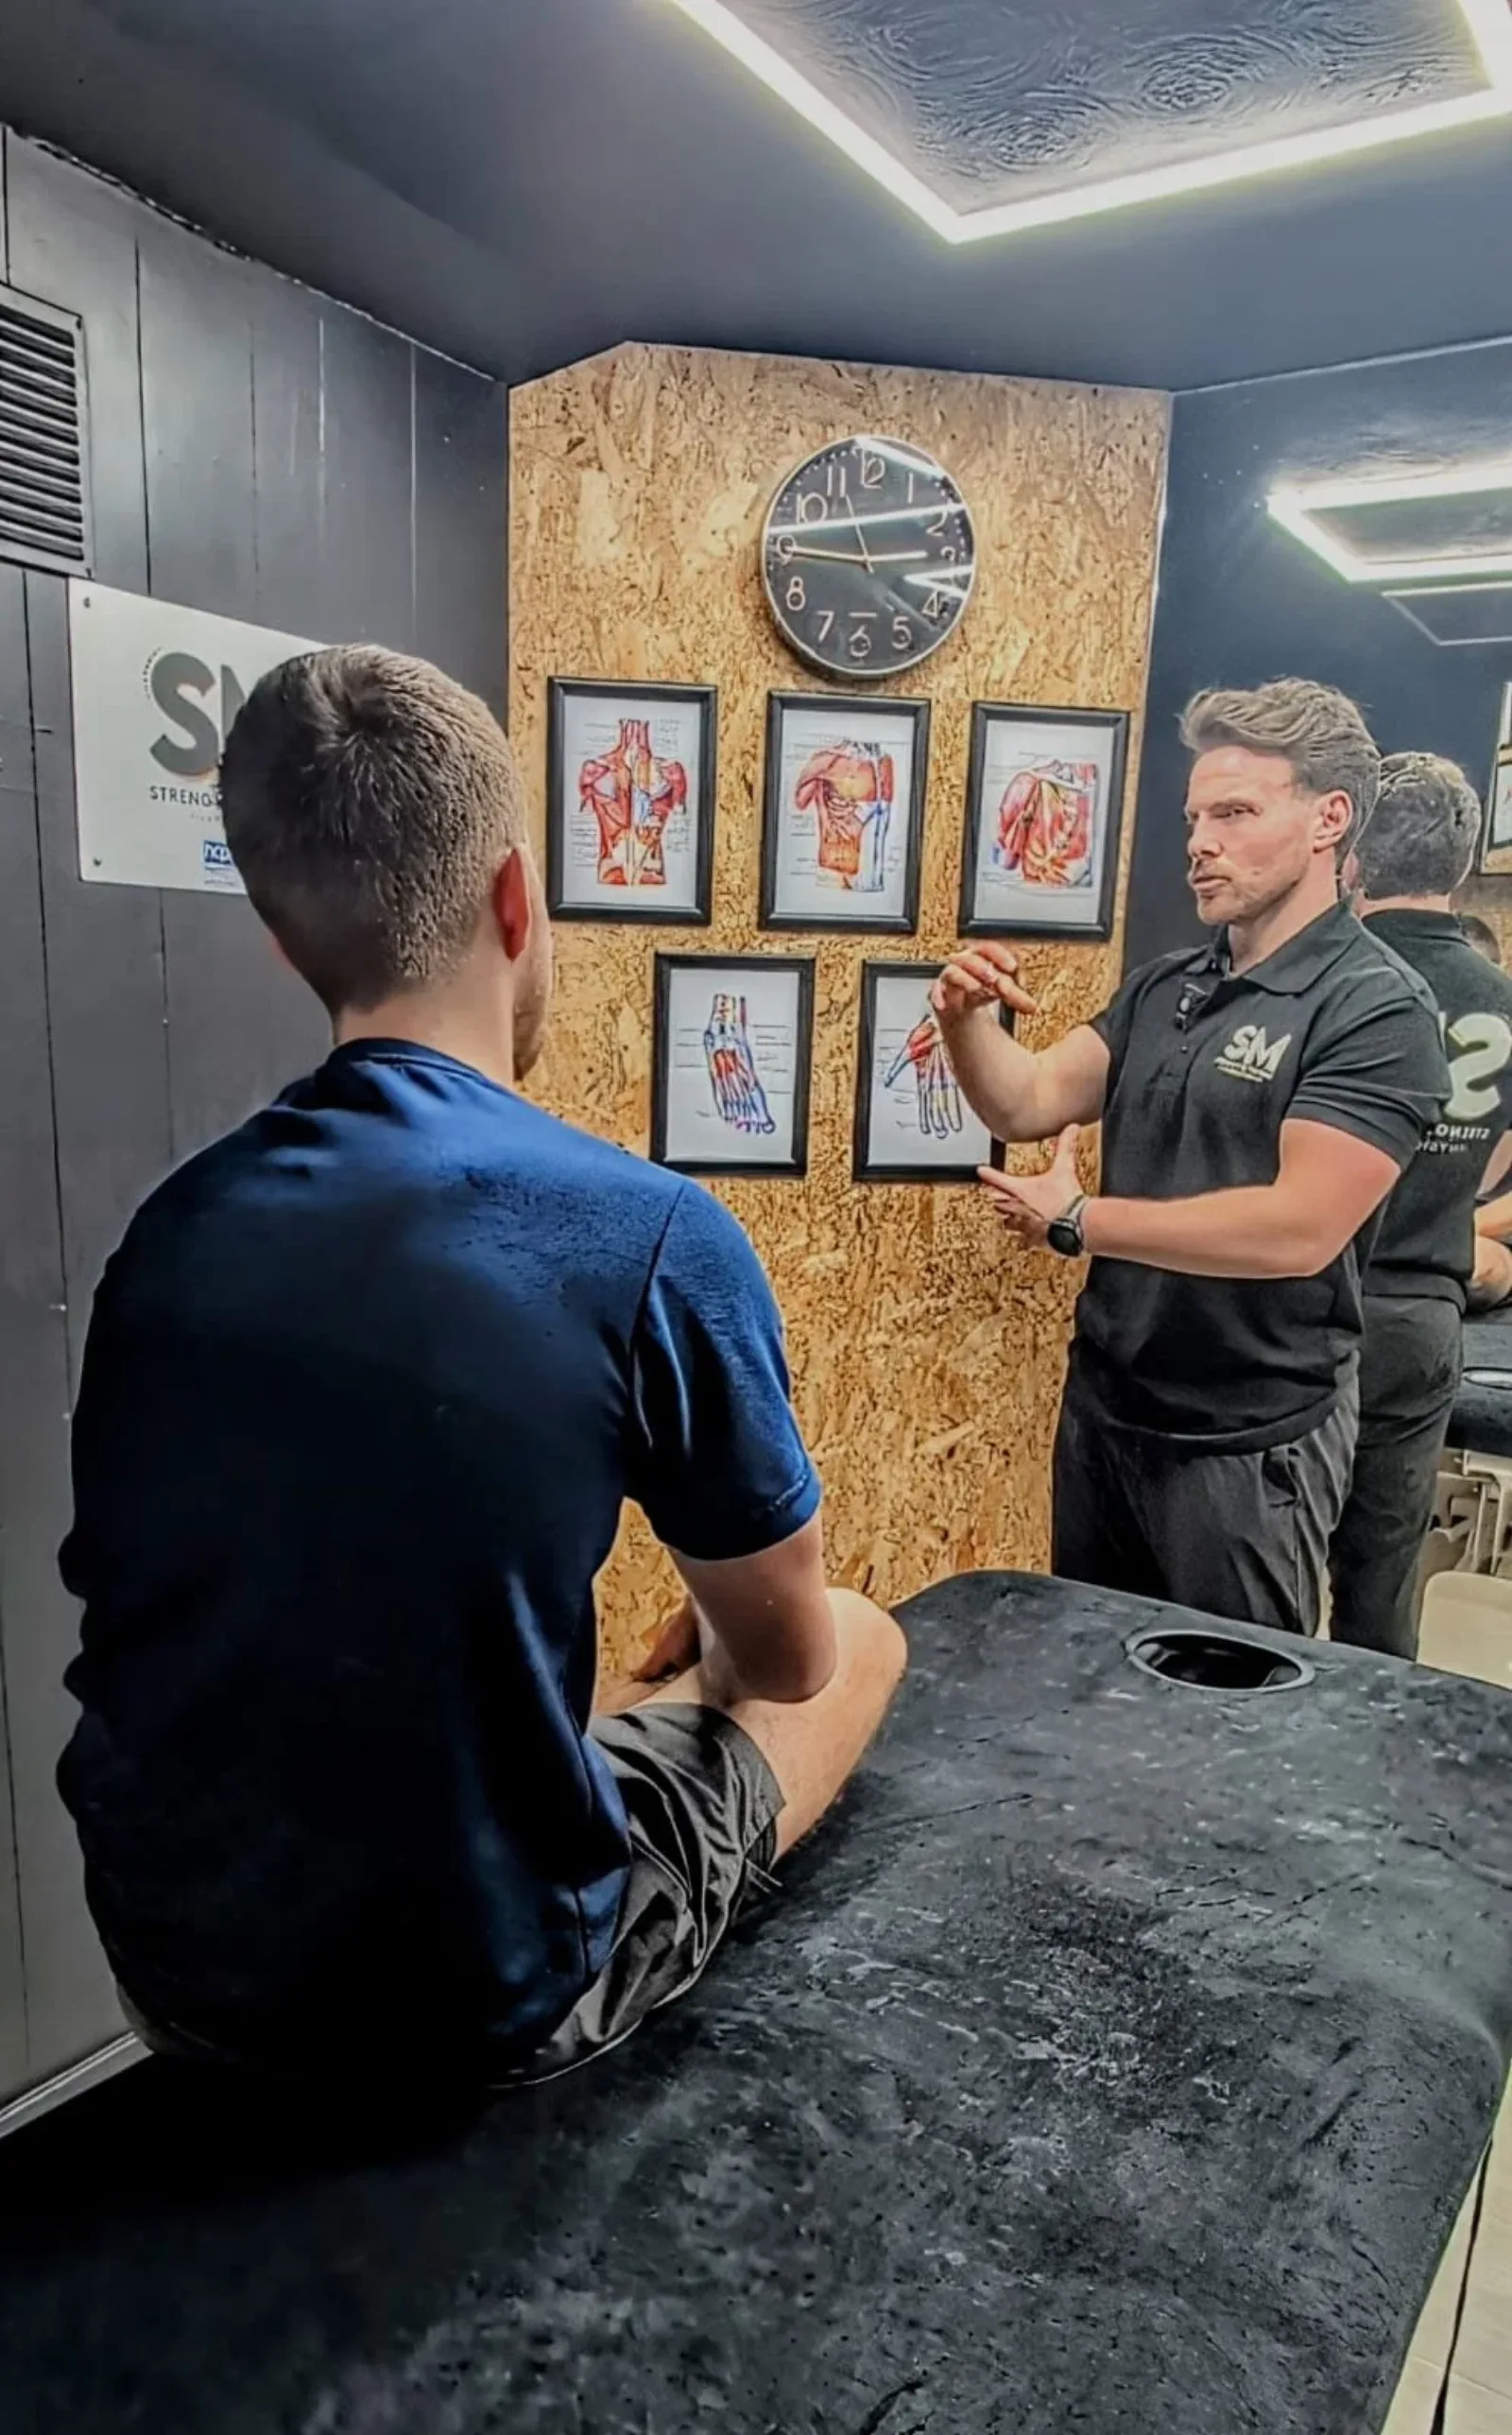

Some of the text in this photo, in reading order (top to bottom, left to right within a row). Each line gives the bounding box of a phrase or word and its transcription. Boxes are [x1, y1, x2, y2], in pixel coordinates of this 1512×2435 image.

[827, 465, 847, 498] 11
[860, 450, 886, 491] 12
[906, 473, 915, 505] 1
[796, 492, 829, 525] 10
[926, 509, 948, 537] 2
[776, 534, 798, 566] 9
[785, 576, 805, 611] 8
[921, 588, 939, 618] 4
[816, 610, 835, 643] 7
[849, 624, 872, 658] 6
[890, 615, 912, 650] 5
[1223, 1024, 1293, 1075] SM
